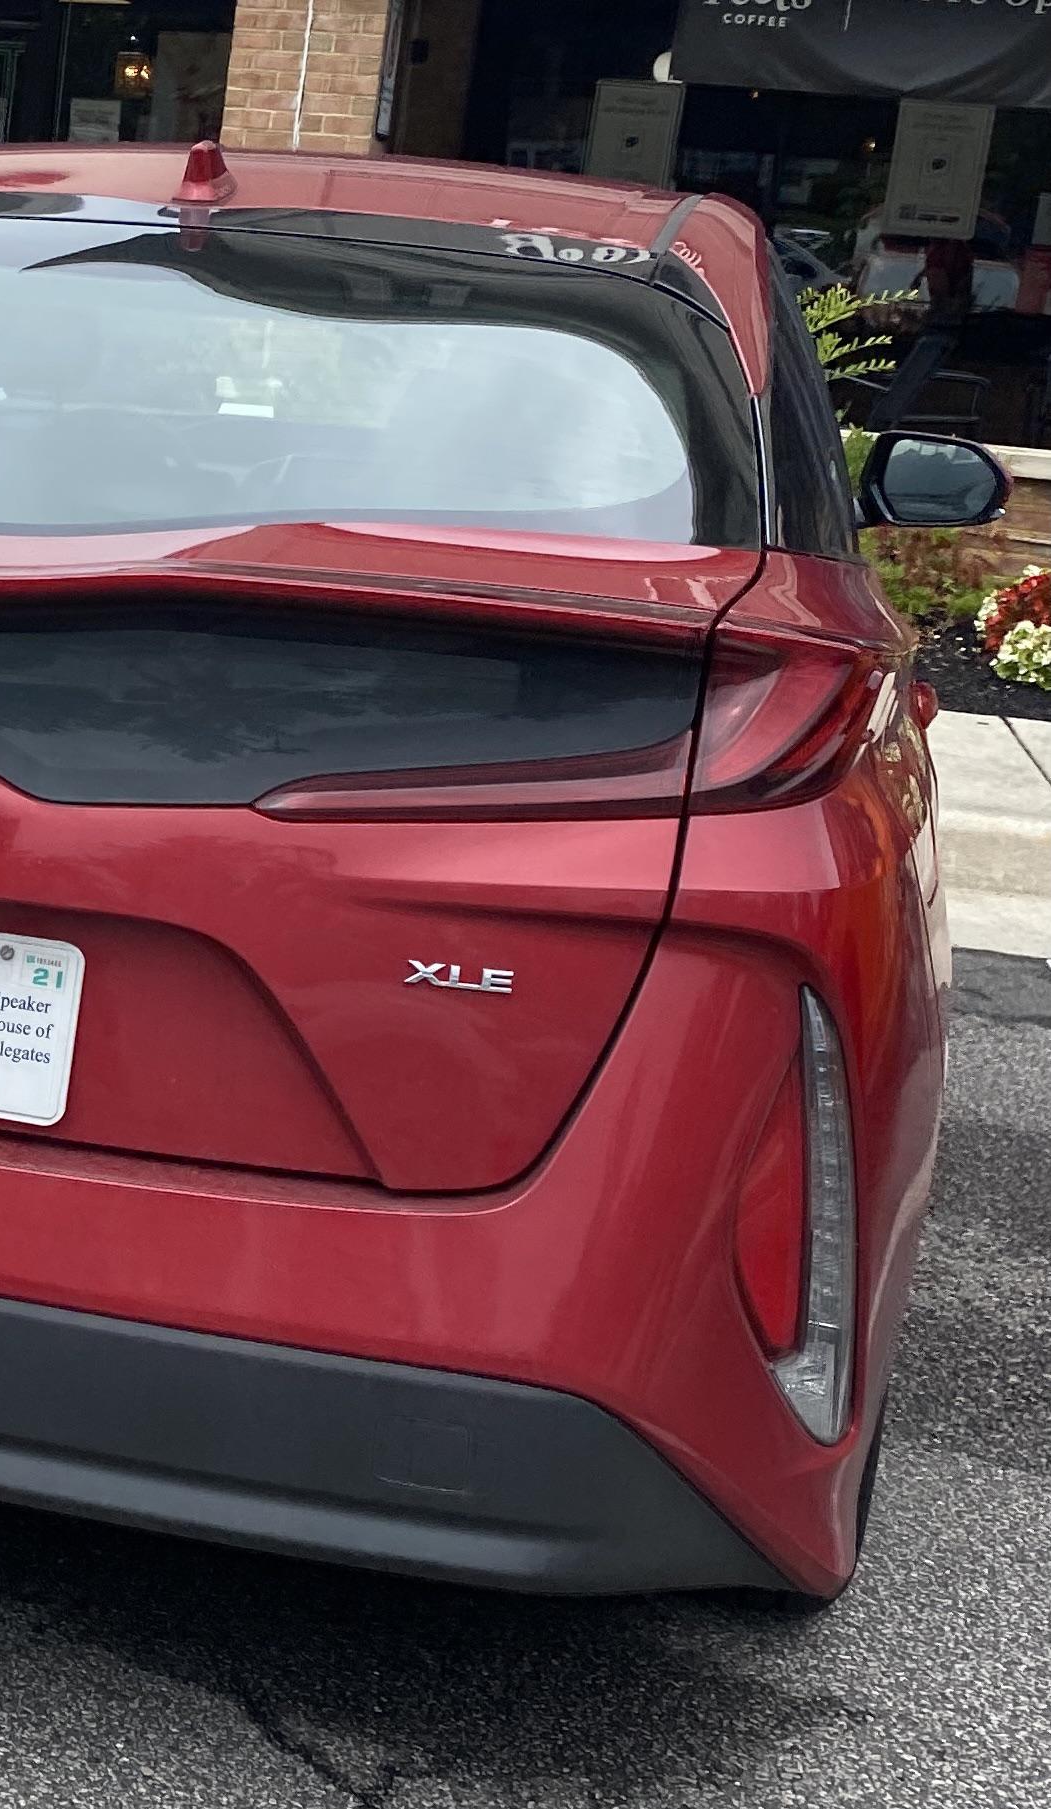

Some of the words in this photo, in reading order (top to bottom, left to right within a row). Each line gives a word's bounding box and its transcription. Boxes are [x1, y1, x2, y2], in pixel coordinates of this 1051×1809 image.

[723, 13, 788, 27] COFFEE
[32, 967, 63, 988] 21
[403, 959, 515, 994] XLE
[35, 1023, 55, 1040] of
